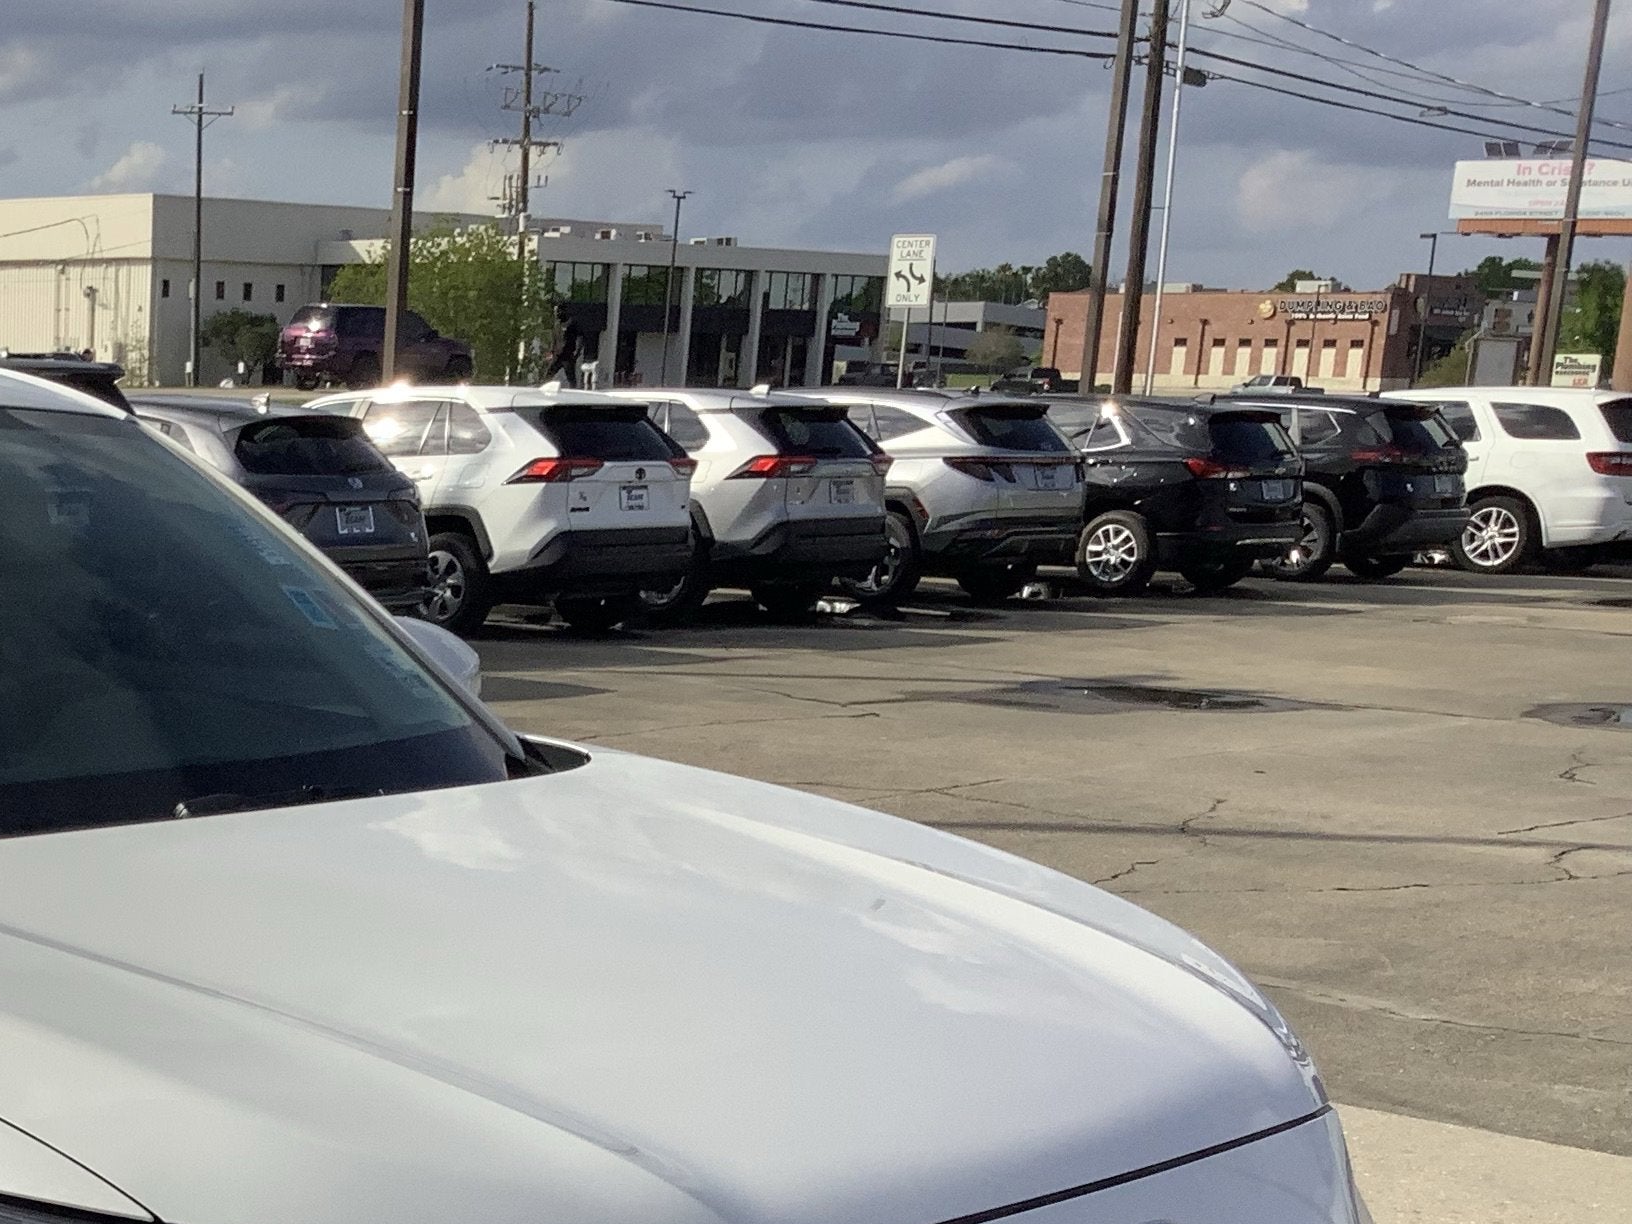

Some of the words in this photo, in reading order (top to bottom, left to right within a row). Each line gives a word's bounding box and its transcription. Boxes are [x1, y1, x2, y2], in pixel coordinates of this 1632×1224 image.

[1516, 162, 1532, 176] In
[1538, 161, 1596, 176] Cris?
[1466, 179, 1504, 188] Mental
[1507, 179, 1543, 188] Health
[1560, 178, 1619, 188] Sstance
[896, 239, 931, 248] CENTER
[900, 249, 924, 258] LANE
[895, 294, 920, 303] ONLY
[1279, 300, 1345, 311] DUMPING
[1358, 300, 1386, 312] BAO
